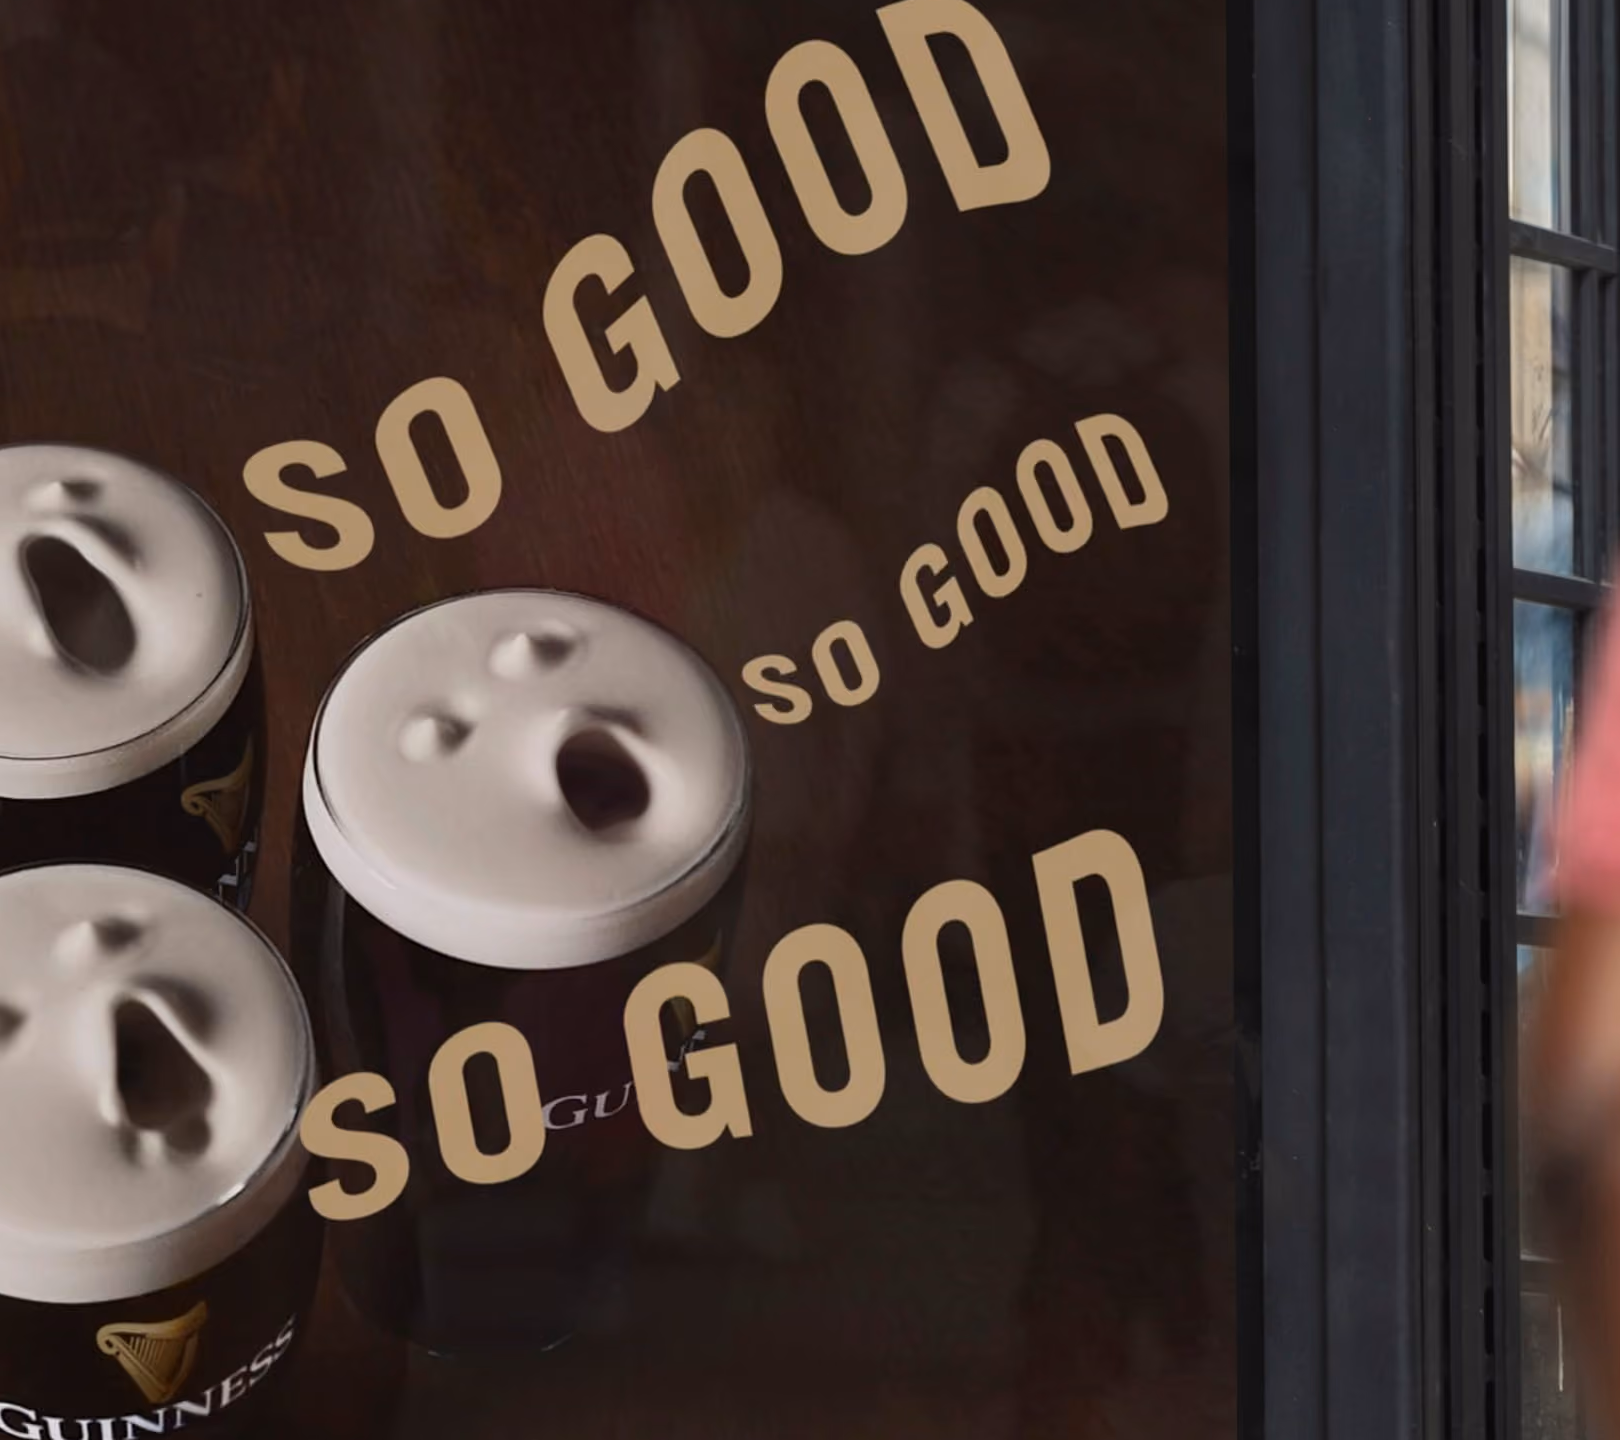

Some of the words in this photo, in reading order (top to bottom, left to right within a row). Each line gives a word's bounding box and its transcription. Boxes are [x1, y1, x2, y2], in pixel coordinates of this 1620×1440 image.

[242, 376, 502, 571] SO
[742, 619, 880, 725] SO
[899, 413, 1169, 649] GOOD
[299, 1021, 546, 1222] SO
[623, 829, 1164, 1150] GOOD
